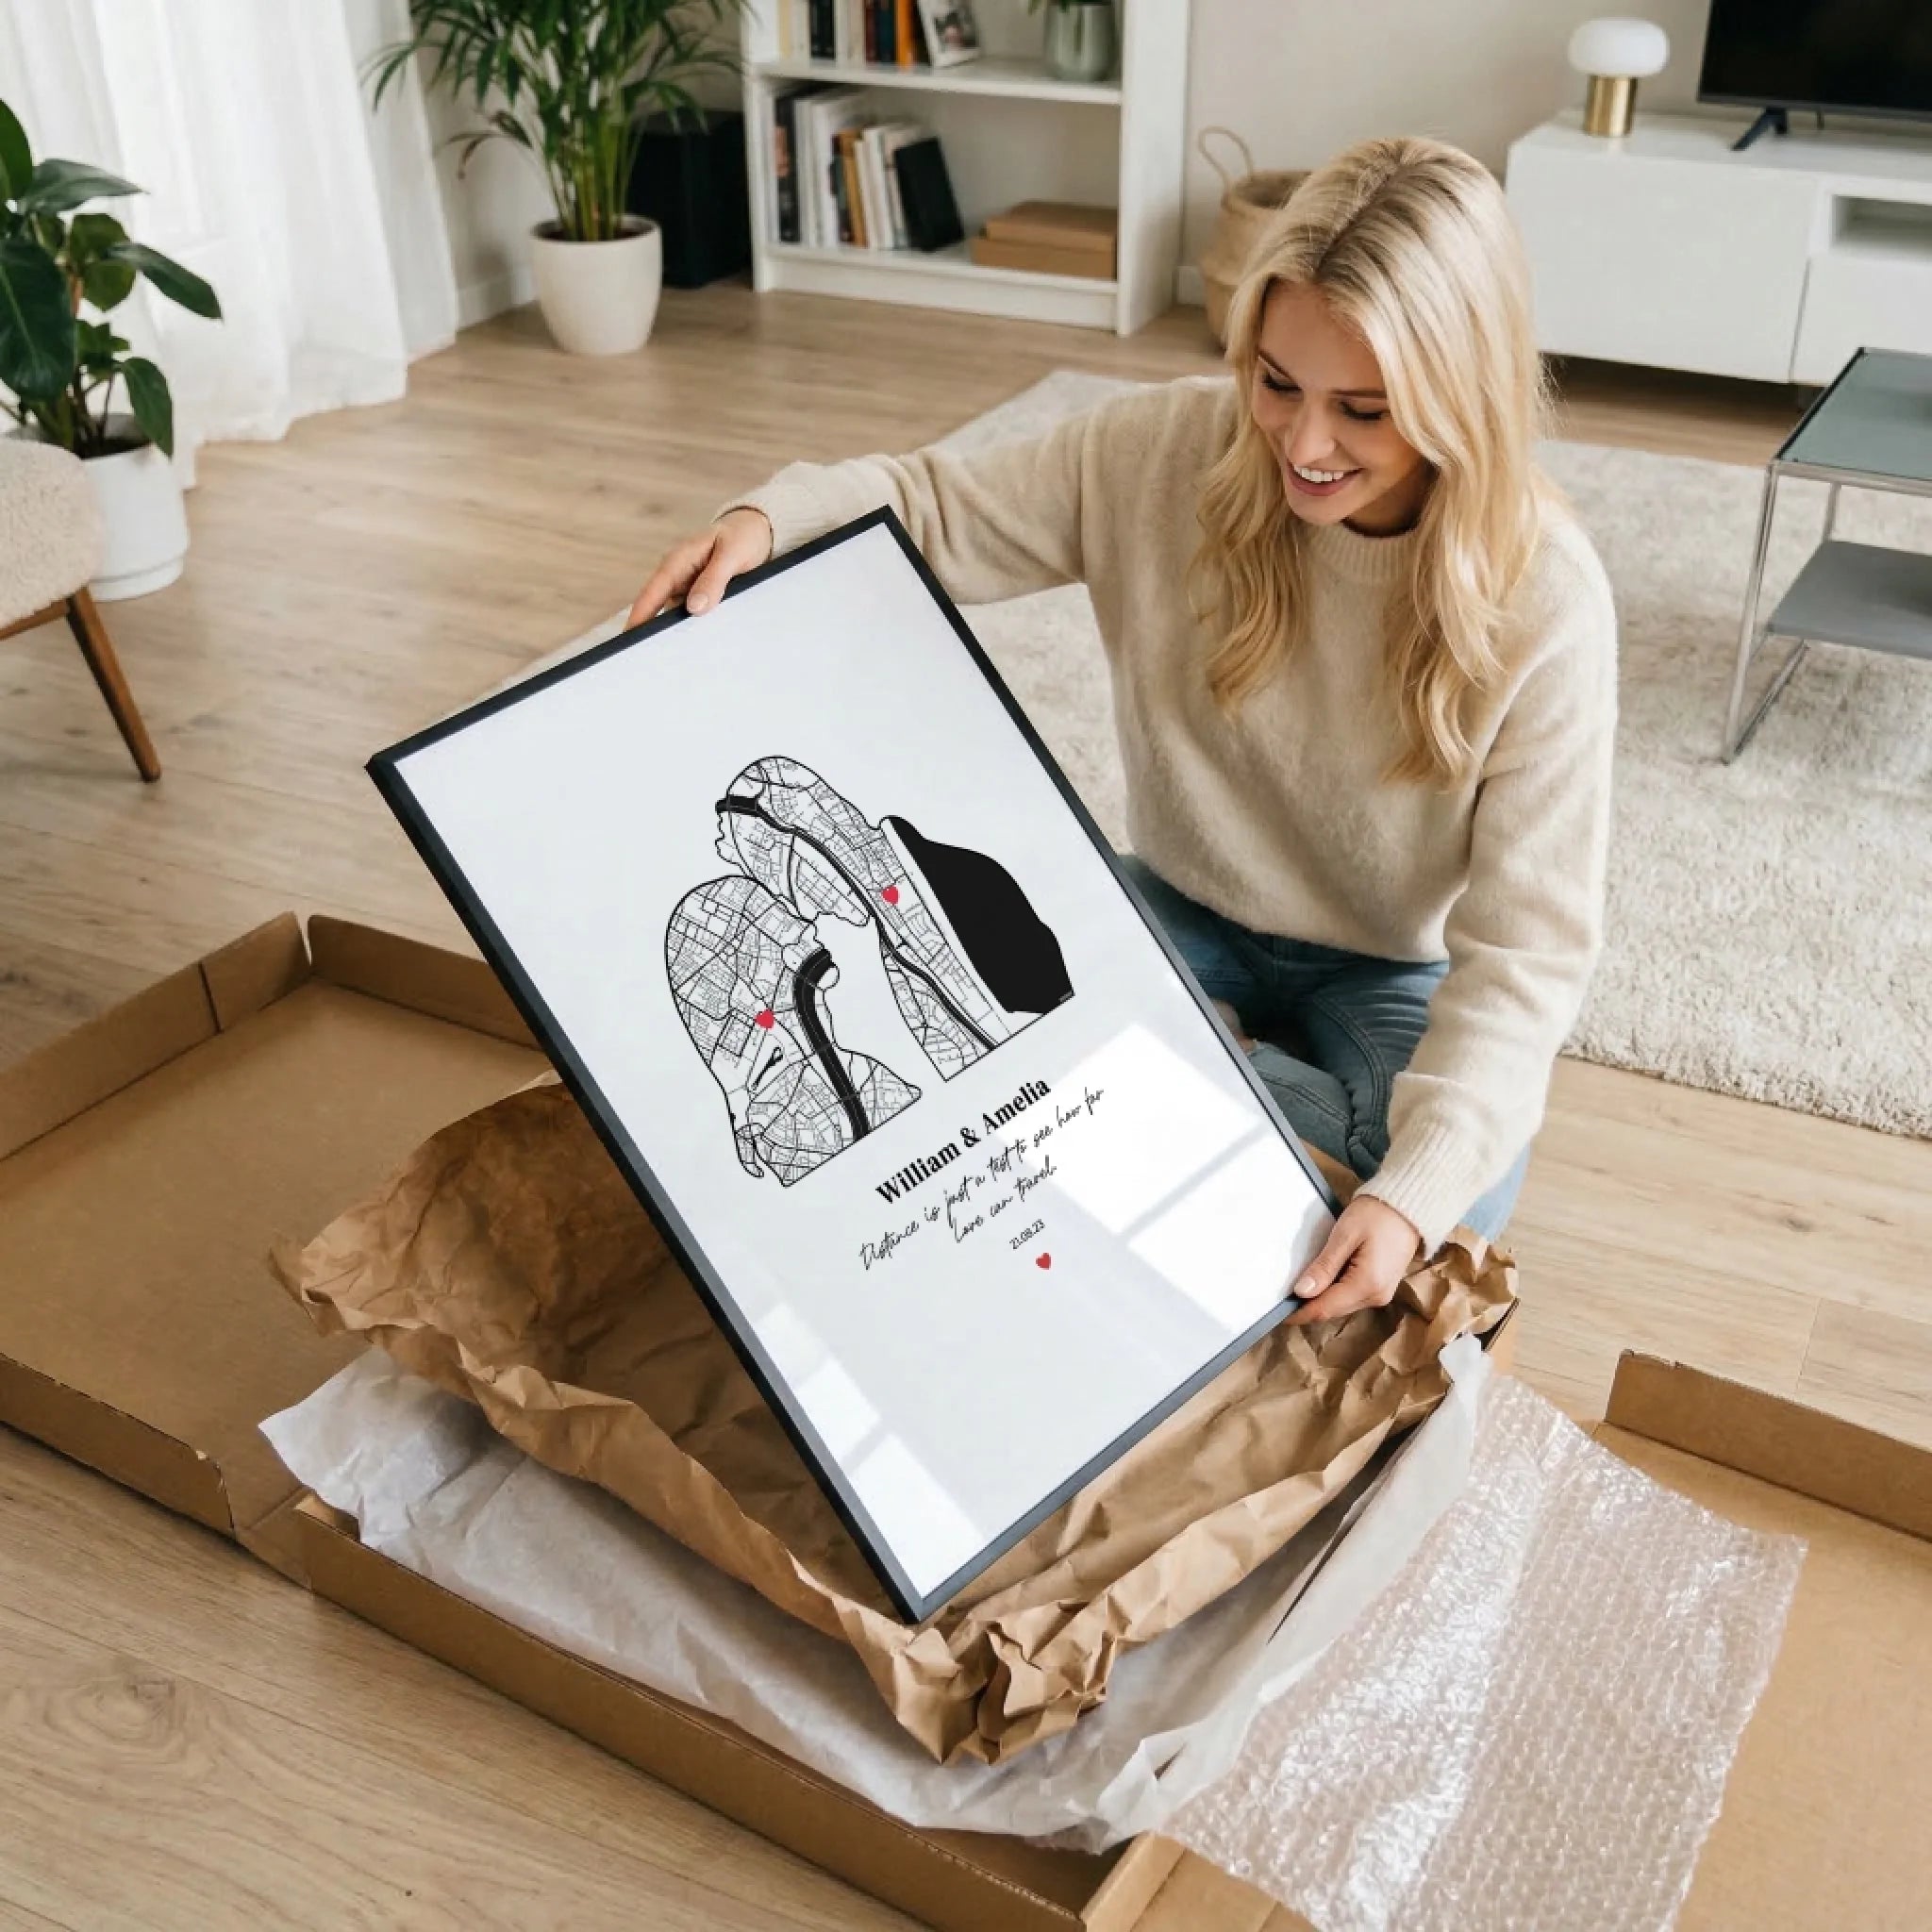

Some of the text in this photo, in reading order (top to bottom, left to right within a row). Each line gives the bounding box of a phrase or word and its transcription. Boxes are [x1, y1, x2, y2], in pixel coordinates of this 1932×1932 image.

[858, 1086, 1105, 1270] Distance is just a test to see how far
[875, 1080, 1052, 1204] William & Amelia
[990, 1195, 1014, 1217] can
[1008, 1218, 1046, 1250] 21.08.23
